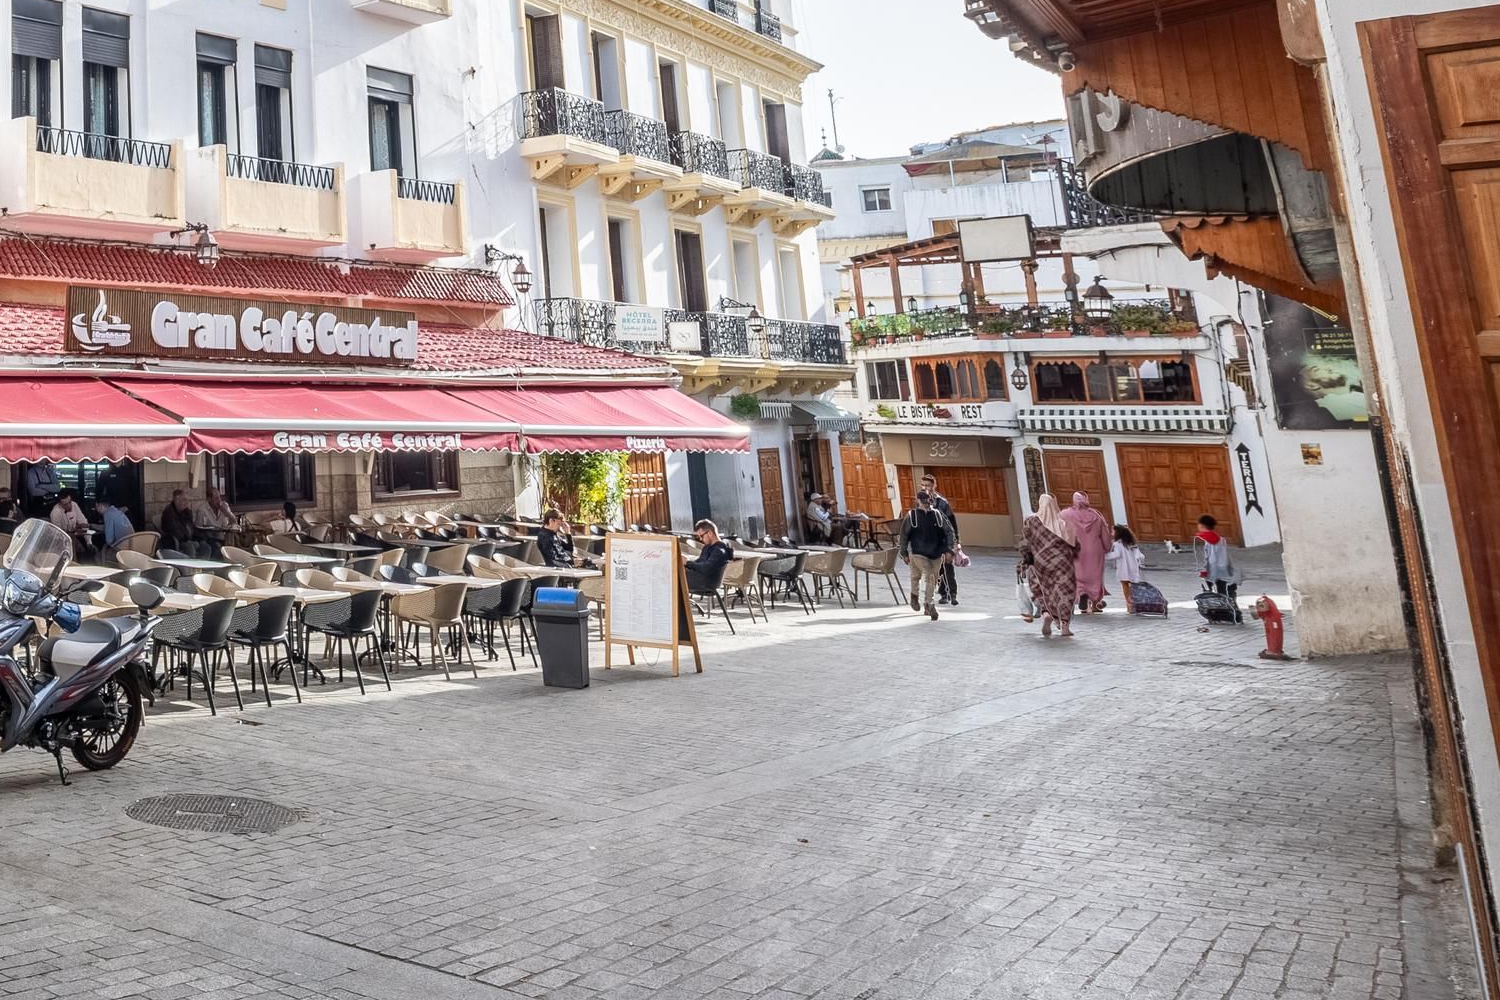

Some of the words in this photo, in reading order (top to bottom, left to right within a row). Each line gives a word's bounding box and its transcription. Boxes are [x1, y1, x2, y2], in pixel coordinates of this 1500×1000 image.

[150, 300, 237, 350] Gran
[240, 306, 315, 354] Café
[315, 311, 418, 361] Central
[897, 405, 908, 418] LE
[960, 405, 983, 419] REST
[273, 431, 327, 448] Gran
[336, 432, 383, 448] Café
[391, 433, 463, 448] Central
[625, 435, 666, 449] Pizzeria
[1044, 437, 1095, 445] RESTAURANT
[1239, 452, 1256, 501] TERASA
